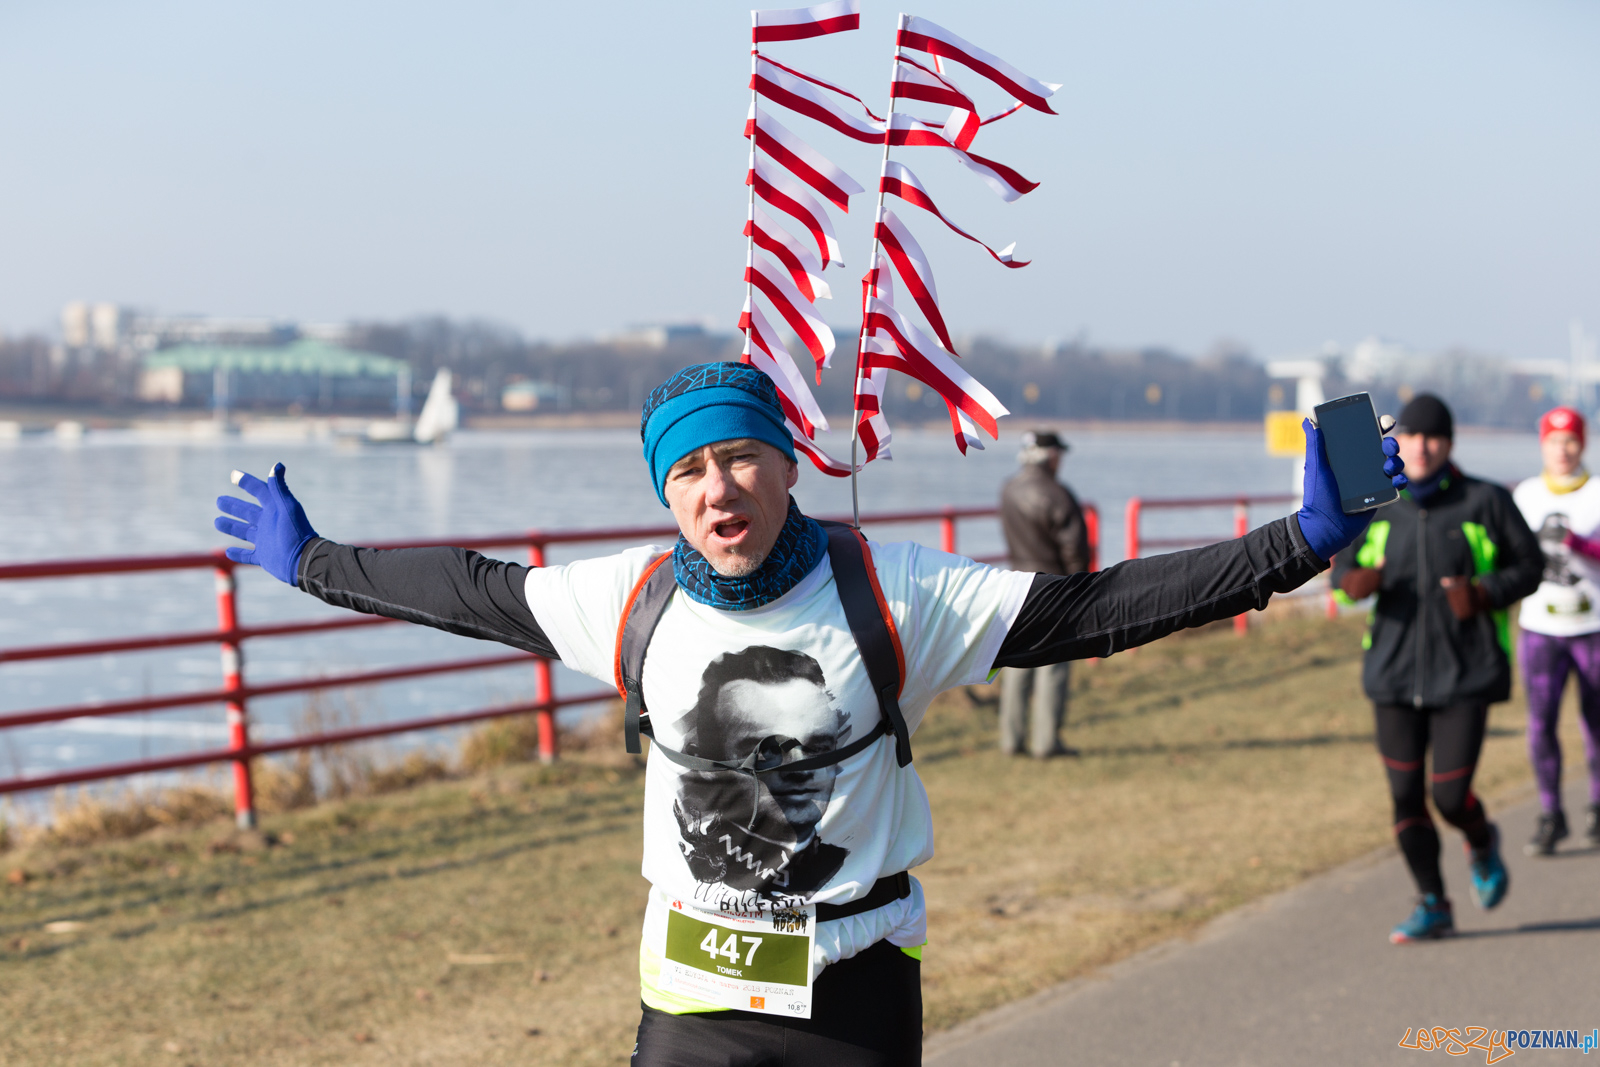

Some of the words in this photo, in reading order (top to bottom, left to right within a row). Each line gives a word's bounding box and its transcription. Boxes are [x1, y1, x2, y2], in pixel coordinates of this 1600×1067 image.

[700, 928, 763, 966] 447
[716, 965, 743, 977] TOMEK
[742, 984, 761, 993] 2018
